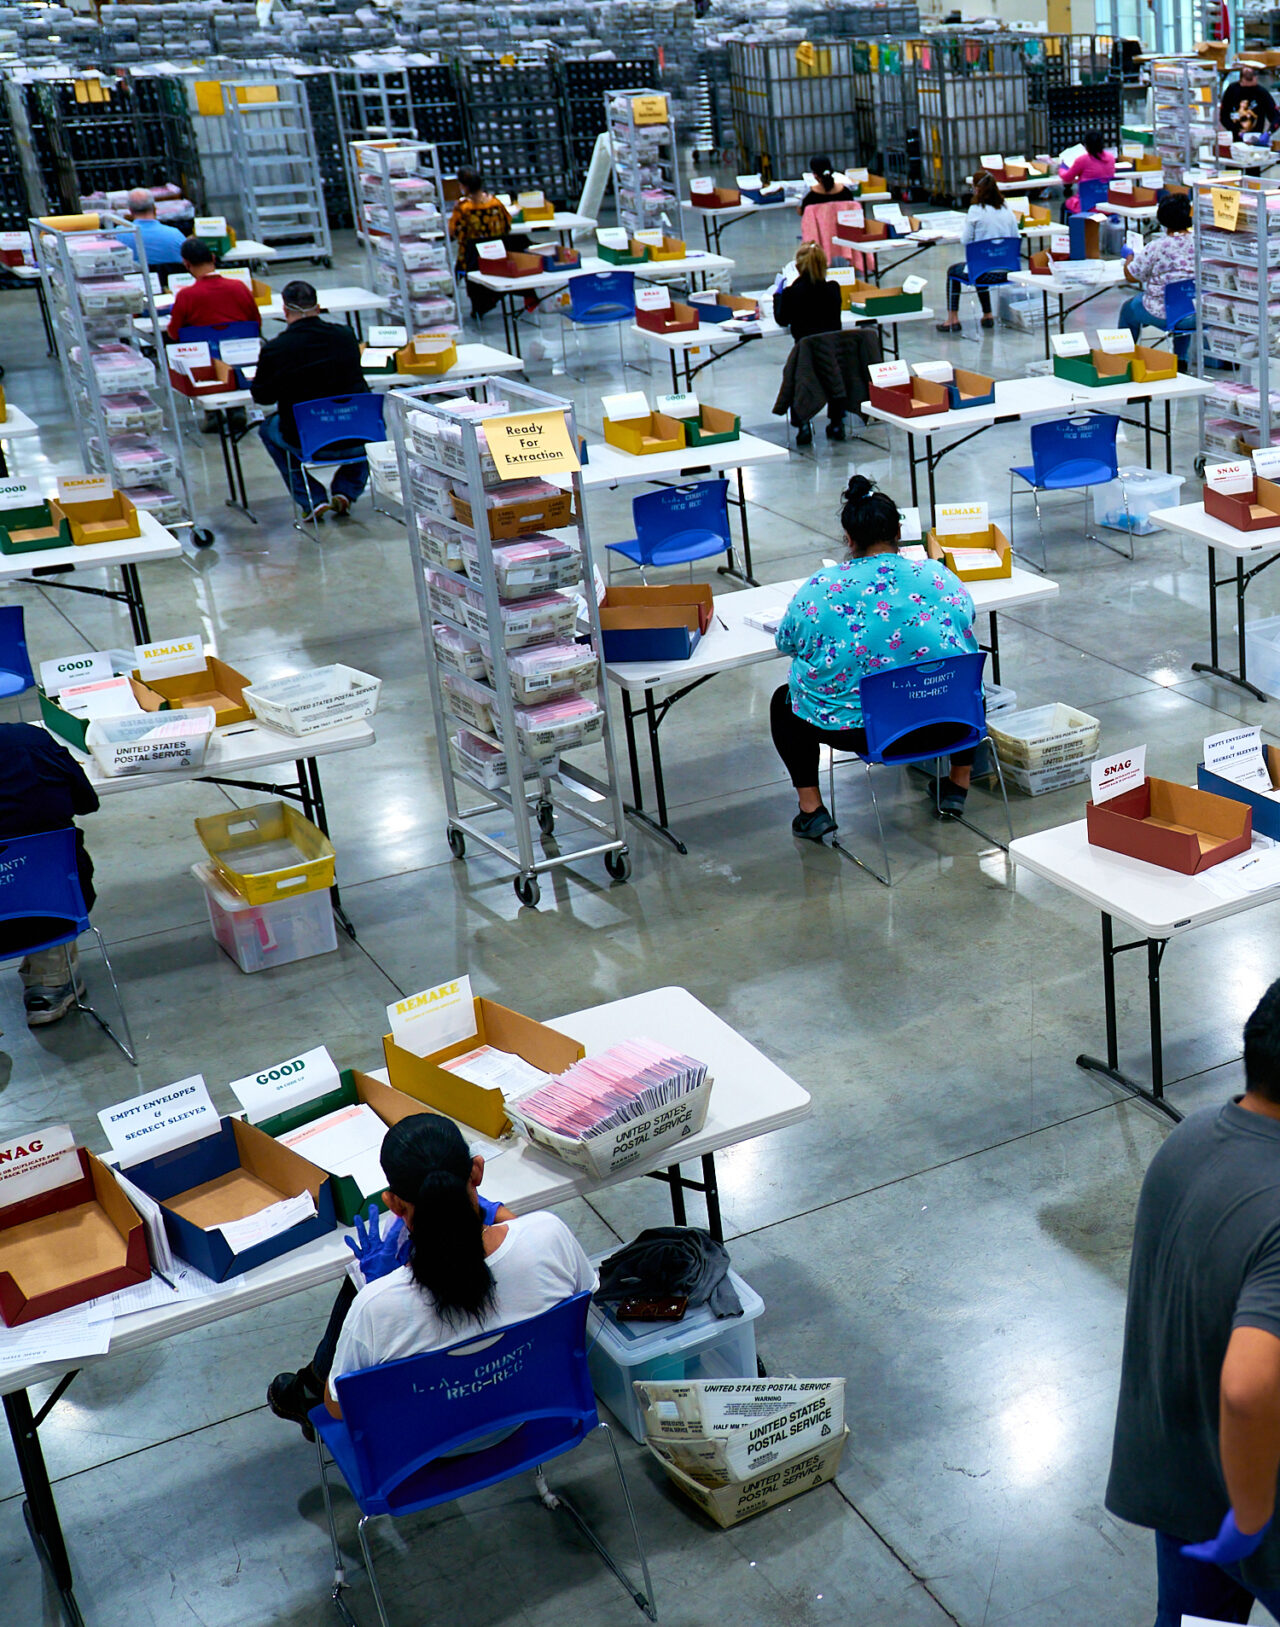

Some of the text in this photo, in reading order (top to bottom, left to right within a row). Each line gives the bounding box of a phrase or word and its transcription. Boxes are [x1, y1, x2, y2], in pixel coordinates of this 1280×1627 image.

[505, 422, 544, 435] Ready
[519, 438, 539, 448] For
[504, 449, 564, 463] Extraction
[1216, 466, 1241, 476] SNAG
[63, 477, 106, 487] REMAKE
[941, 506, 982, 517] REMAKE
[143, 642, 196, 659] REMAKE
[57, 659, 94, 673] GOOD
[892, 670, 956, 689] L.A. COUNTY
[290, 685, 378, 713] UNITED STATES POSTAL SERVICE
[114, 748, 192, 764] POSTAL SERVICE
[116, 741, 187, 756] UNITED STATES
[1103, 760, 1132, 777] SNAG
[396, 982, 461, 1015] REMAKE
[255, 1059, 306, 1086] GOOD
[110, 1086, 196, 1122] EMPTY ENVELOPES
[167, 1105, 207, 1125] SLEEVES
[616, 1103, 688, 1144] UNITED STATES
[612, 1110, 693, 1157] POSTAL SERVICE
[0, 1140, 44, 1165] NAG
[412, 1338, 536, 1394] L.A. COUNTY
[704, 1384, 735, 1393] UNITED
[766, 1383, 798, 1392] POSTAL
[748, 1417, 788, 1441] UNITED
[788, 1398, 826, 1423] STATES
[747, 1431, 792, 1456] POSTAL
[792, 1407, 832, 1439] SERVICE
[737, 1460, 826, 1507] POSTAL SERVICE
[742, 1455, 820, 1494] UNITED STATES
